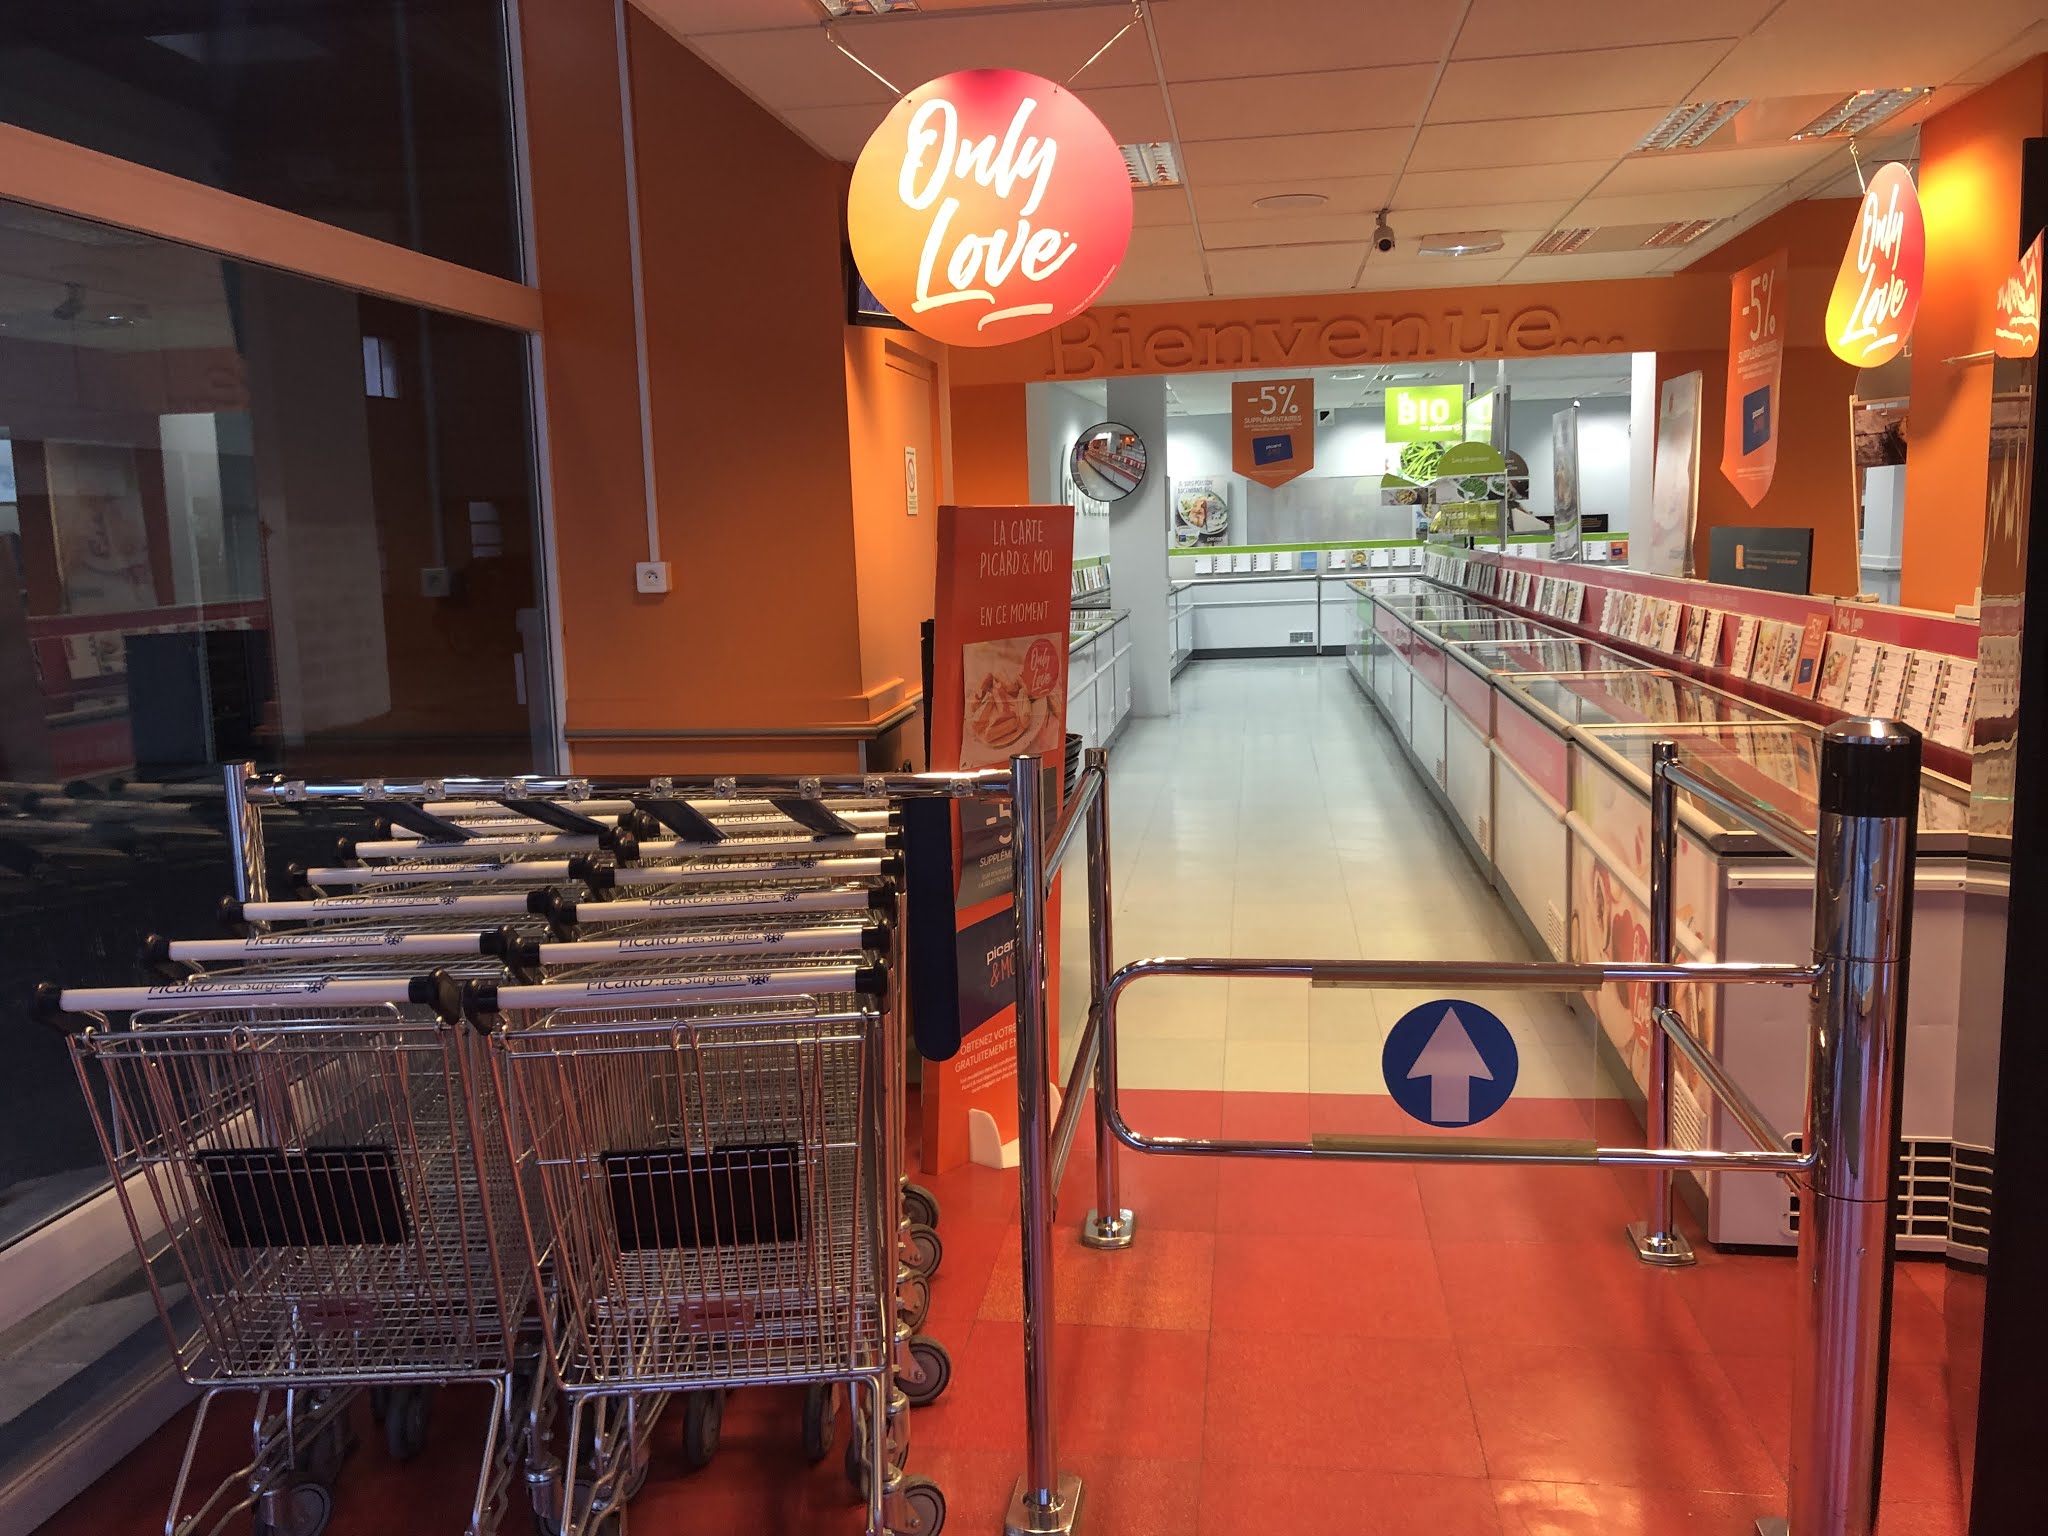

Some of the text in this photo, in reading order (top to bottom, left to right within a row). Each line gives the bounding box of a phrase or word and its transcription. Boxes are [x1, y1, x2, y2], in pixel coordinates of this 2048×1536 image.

[898, 97, 1058, 217] Only
[1857, 183, 1904, 274] Only
[1742, 268, 1776, 342] -5%
[1247, 384, 1299, 415] -5%
[1397, 398, 1450, 426] BIO
[1243, 414, 1303, 424] SUPPLÉMENTAIRES
[993, 518, 1044, 546] LA CARTE
[980, 548, 1053, 579] PICARD & MOI
[980, 600, 1050, 627] EN CE MOMENT
[1030, 647, 1051, 672] Only
[1032, 668, 1053, 692] Love
[986, 938, 1016, 966] picar
[990, 961, 1000, 988] &
[960, 1022, 1017, 1056] OBTENEZ VOTRE
[954, 1039, 1010, 1073] GRATUITEMENT
